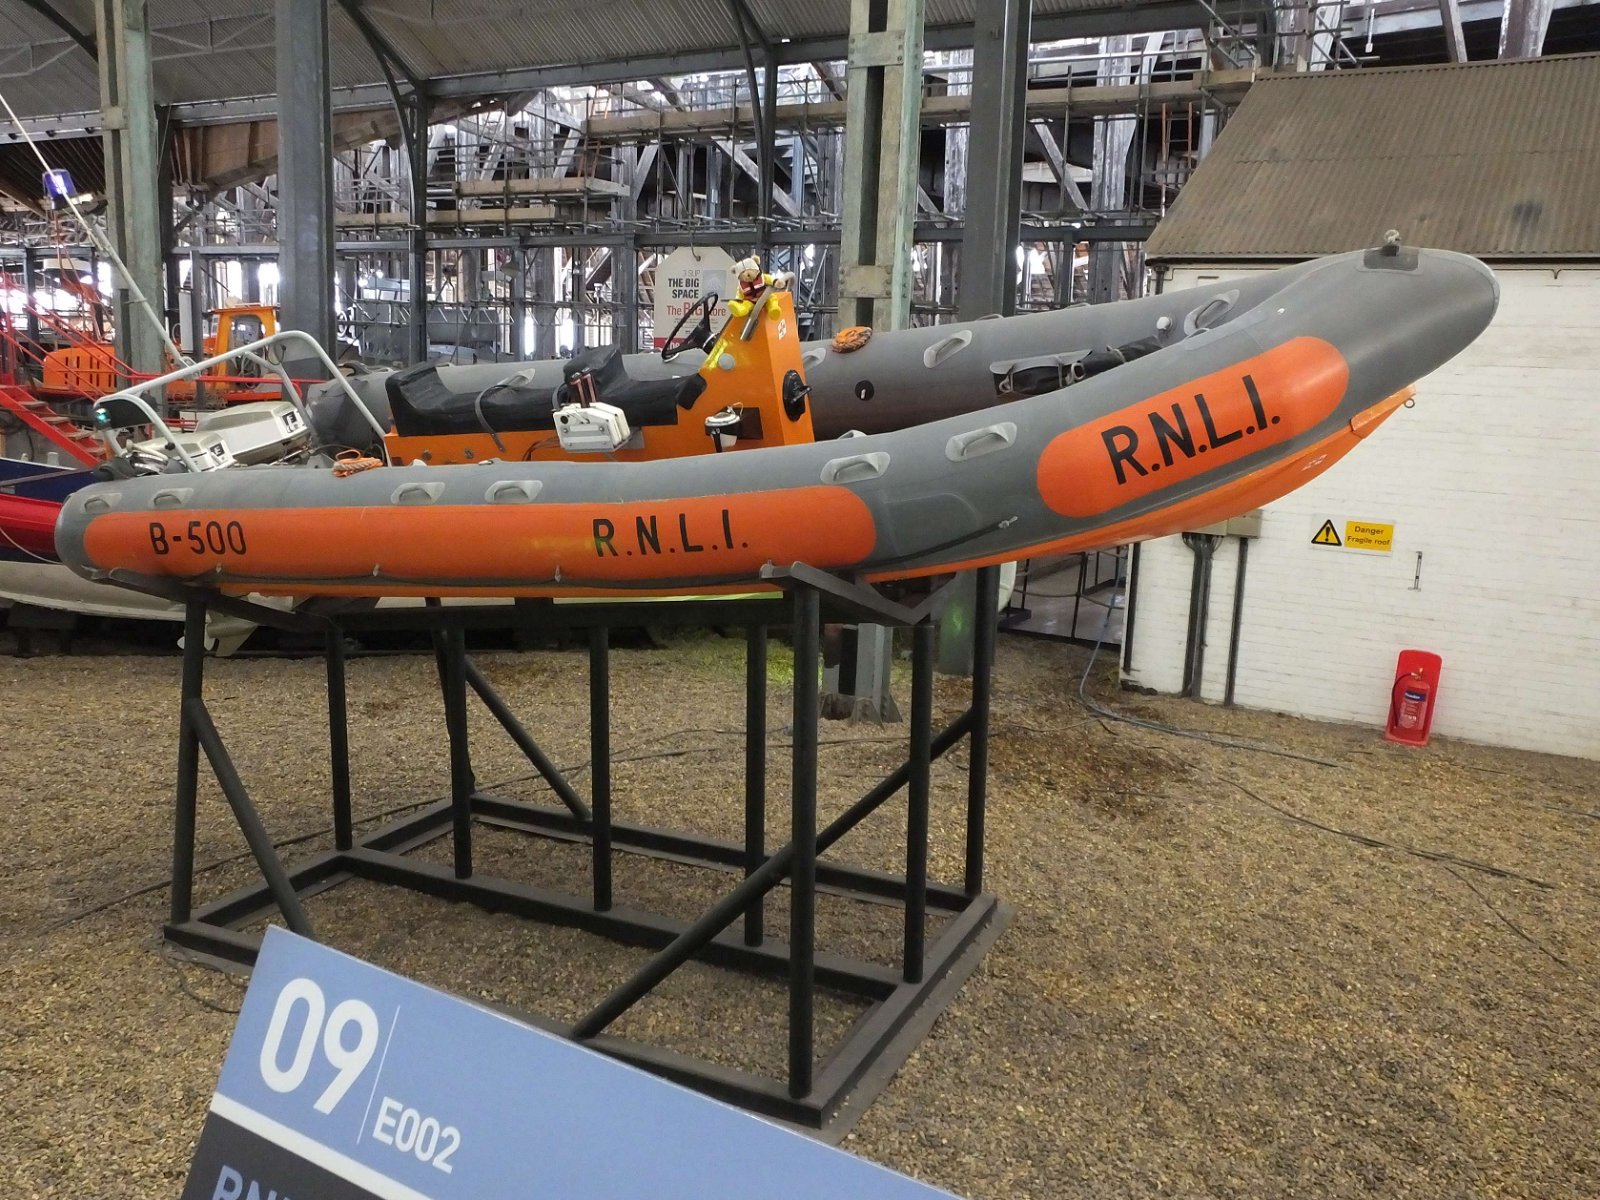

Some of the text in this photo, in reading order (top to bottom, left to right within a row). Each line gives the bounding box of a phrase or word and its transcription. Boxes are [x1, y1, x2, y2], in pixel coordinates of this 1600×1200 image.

[668, 278, 700, 288] THE BIG
[672, 289, 699, 299] SPACE
[666, 304, 682, 316] The
[1101, 374, 1281, 485] R.N.L.I.
[149, 520, 247, 555] B-500
[592, 509, 749, 557] R.N.L.I.
[1347, 535, 1372, 544] Fragile
[1354, 525, 1384, 536] Danger
[260, 977, 380, 1116] 09
[371, 1096, 462, 1175] E002
